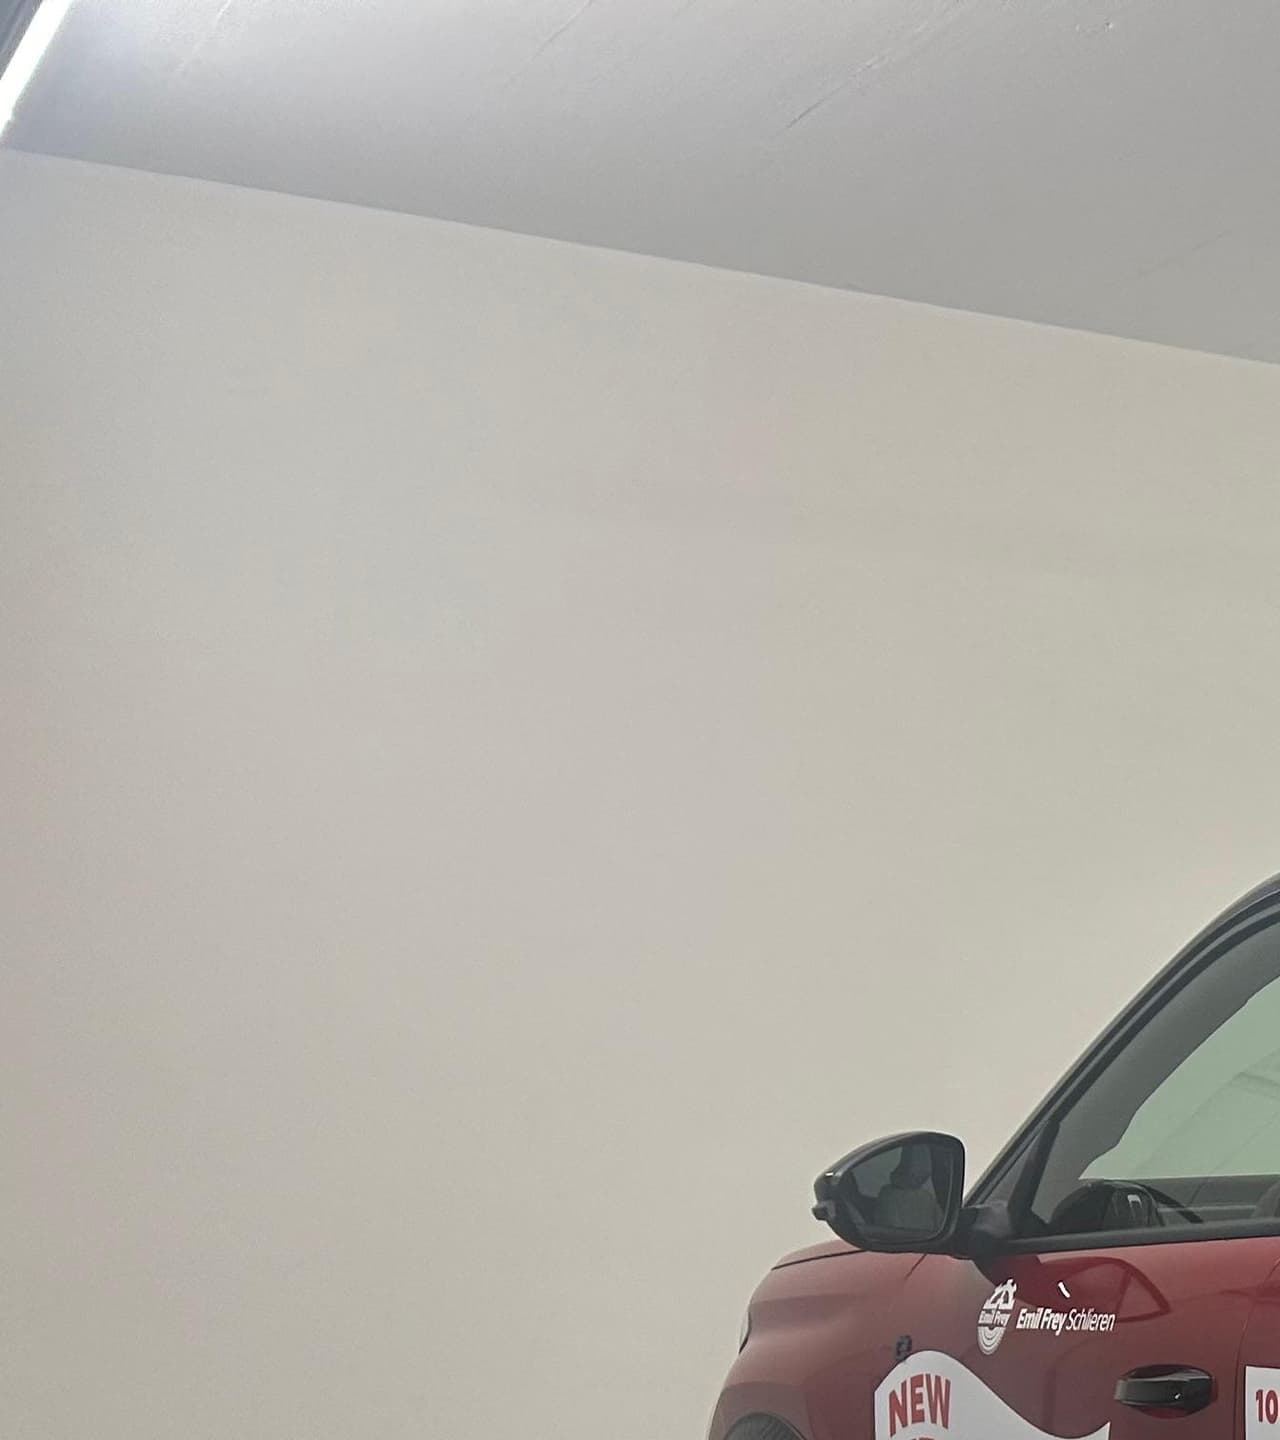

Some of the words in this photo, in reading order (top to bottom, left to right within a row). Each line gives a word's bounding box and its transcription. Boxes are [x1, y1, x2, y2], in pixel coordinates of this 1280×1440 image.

[1016, 1307, 1044, 1329] Emil
[1040, 1308, 1068, 1336] Frey
[1066, 1308, 1116, 1332] Schlieren
[888, 1373, 951, 1437] NEW
